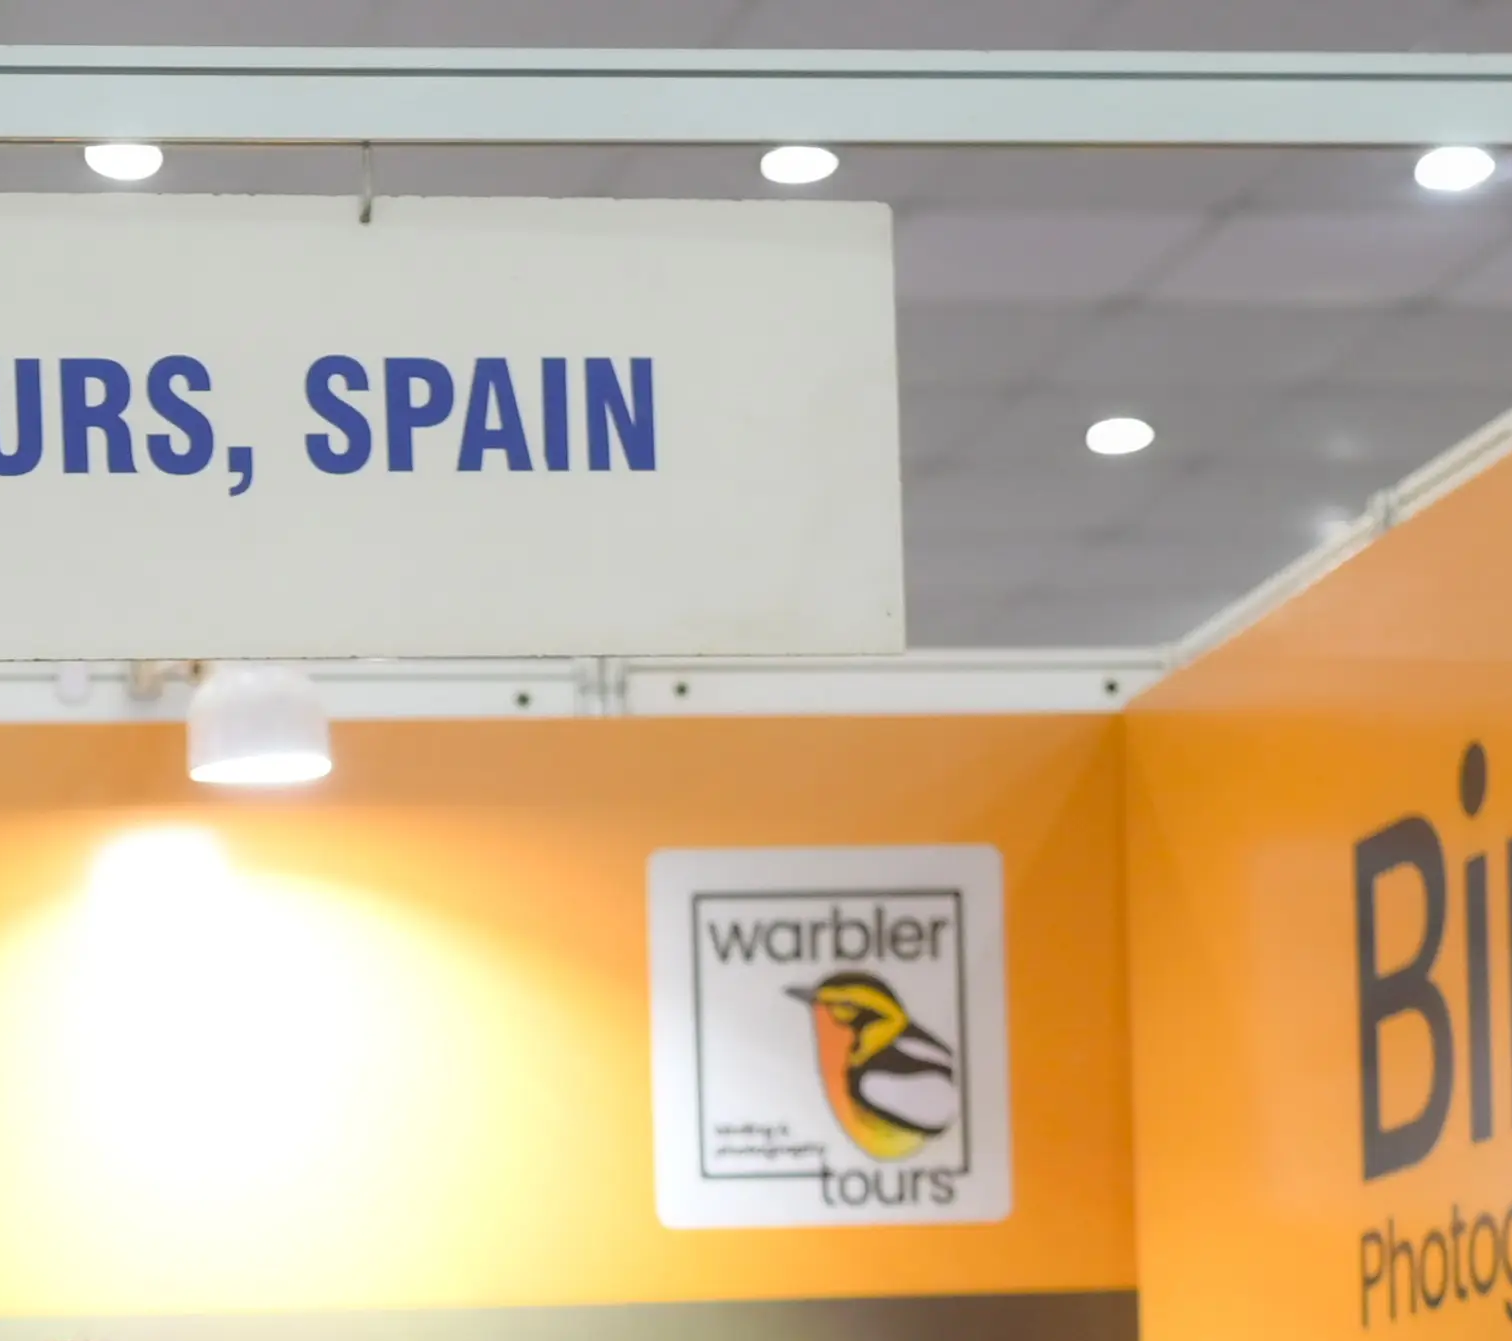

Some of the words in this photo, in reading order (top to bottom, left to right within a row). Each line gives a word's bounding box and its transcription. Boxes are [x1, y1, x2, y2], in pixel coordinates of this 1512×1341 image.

[303, 354, 657, 474] SPAIN
[707, 903, 950, 964] warbler
[818, 1158, 956, 1207] tours
